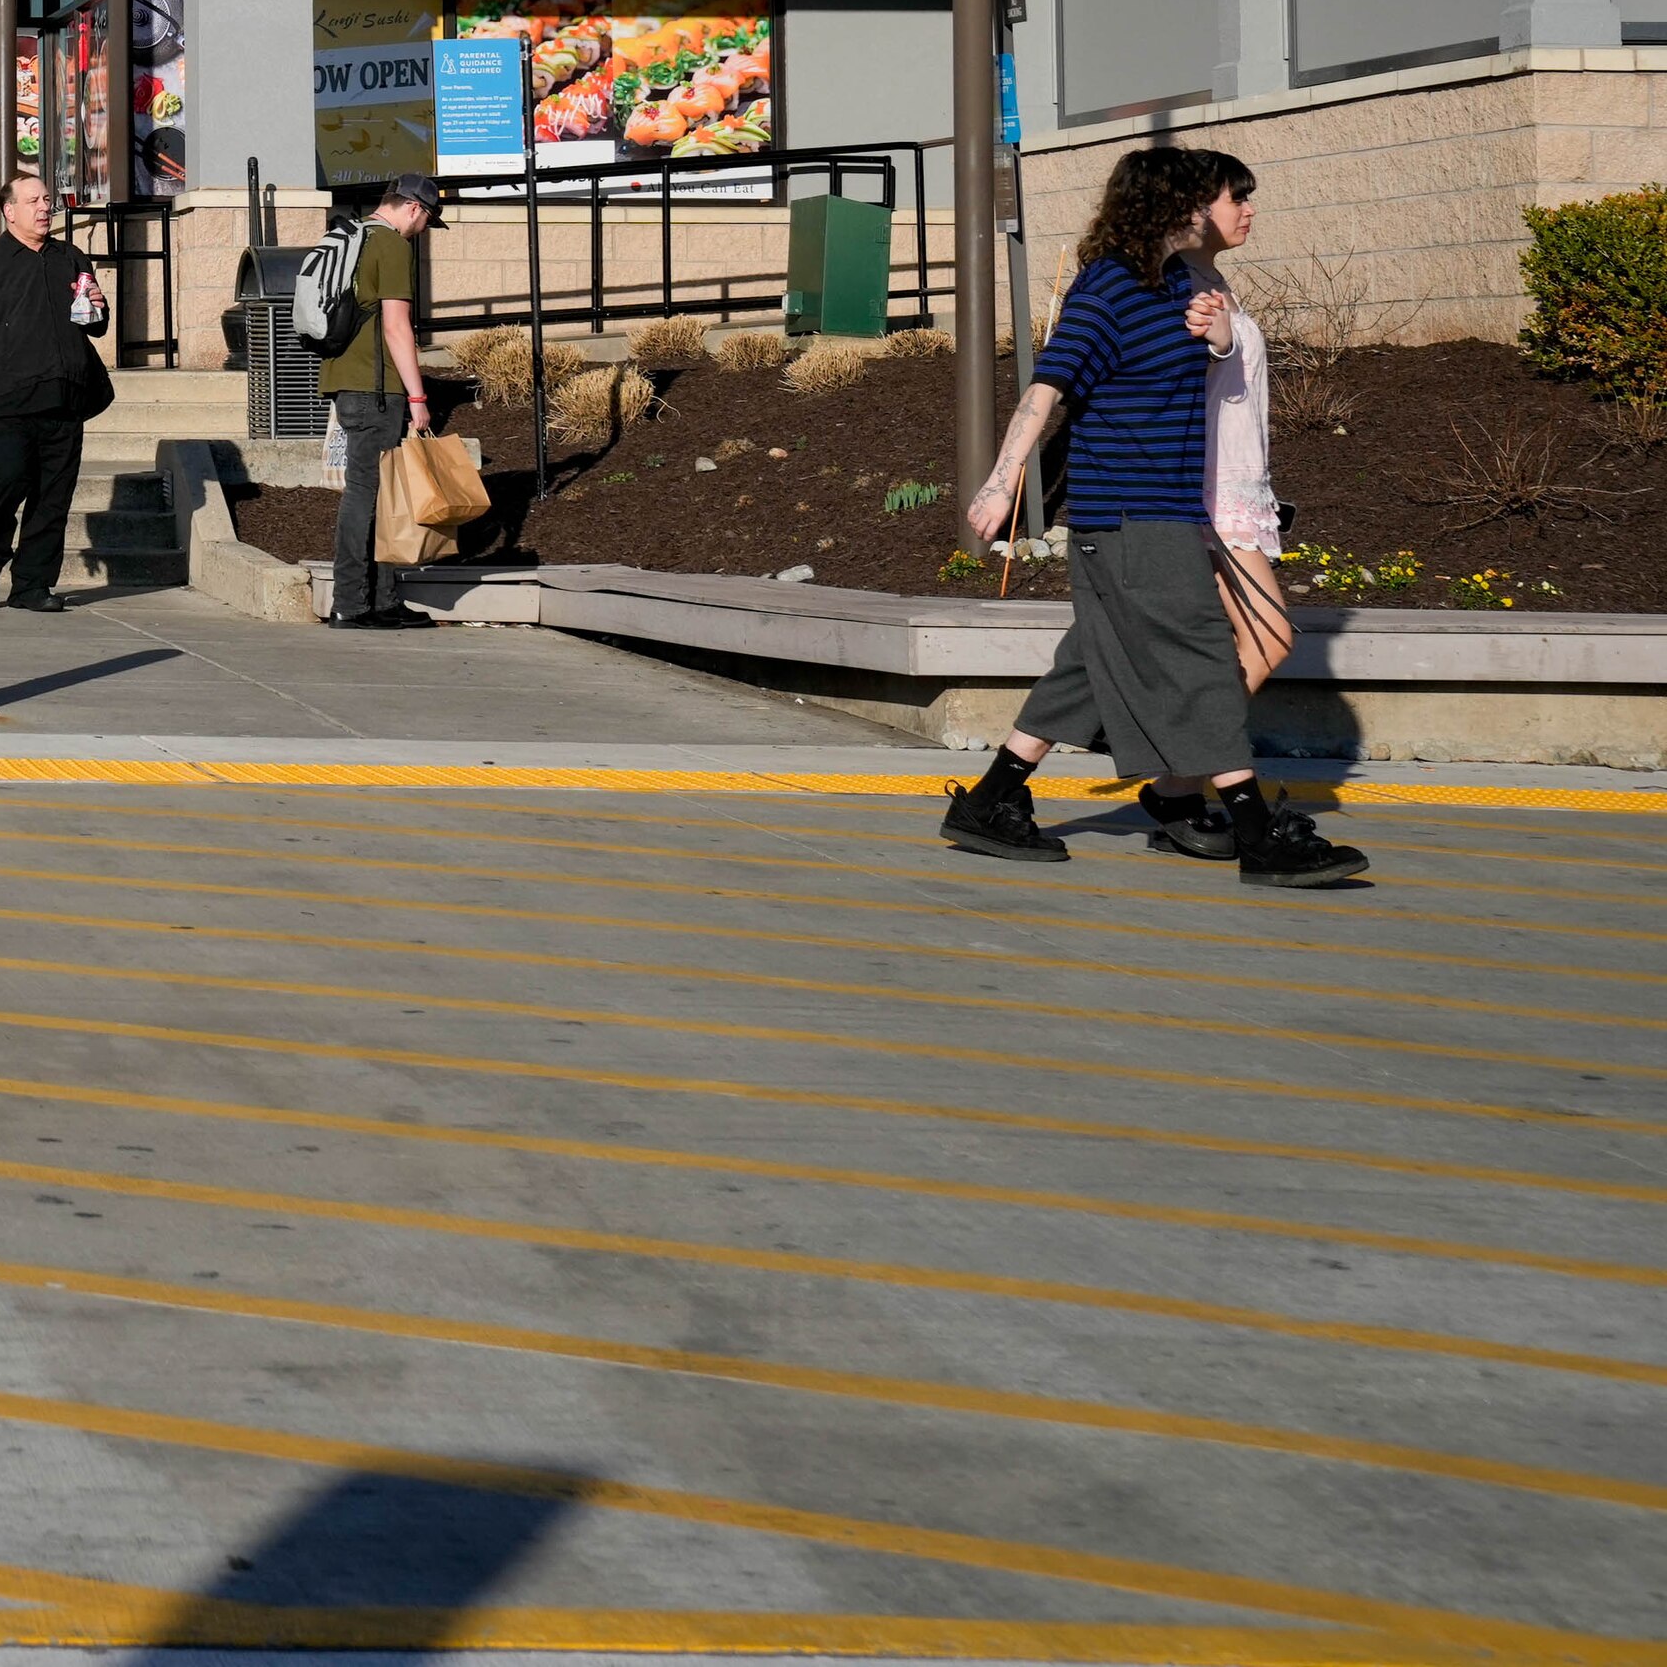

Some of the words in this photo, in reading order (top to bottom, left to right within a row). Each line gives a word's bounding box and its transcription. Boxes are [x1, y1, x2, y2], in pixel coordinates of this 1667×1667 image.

[363, 10, 411, 28] Sushi
[314, 64, 352, 94] OW
[360, 57, 430, 91] OPEN
[672, 182, 697, 194] You
[701, 182, 727, 194] Can
[733, 182, 755, 194] Eat
